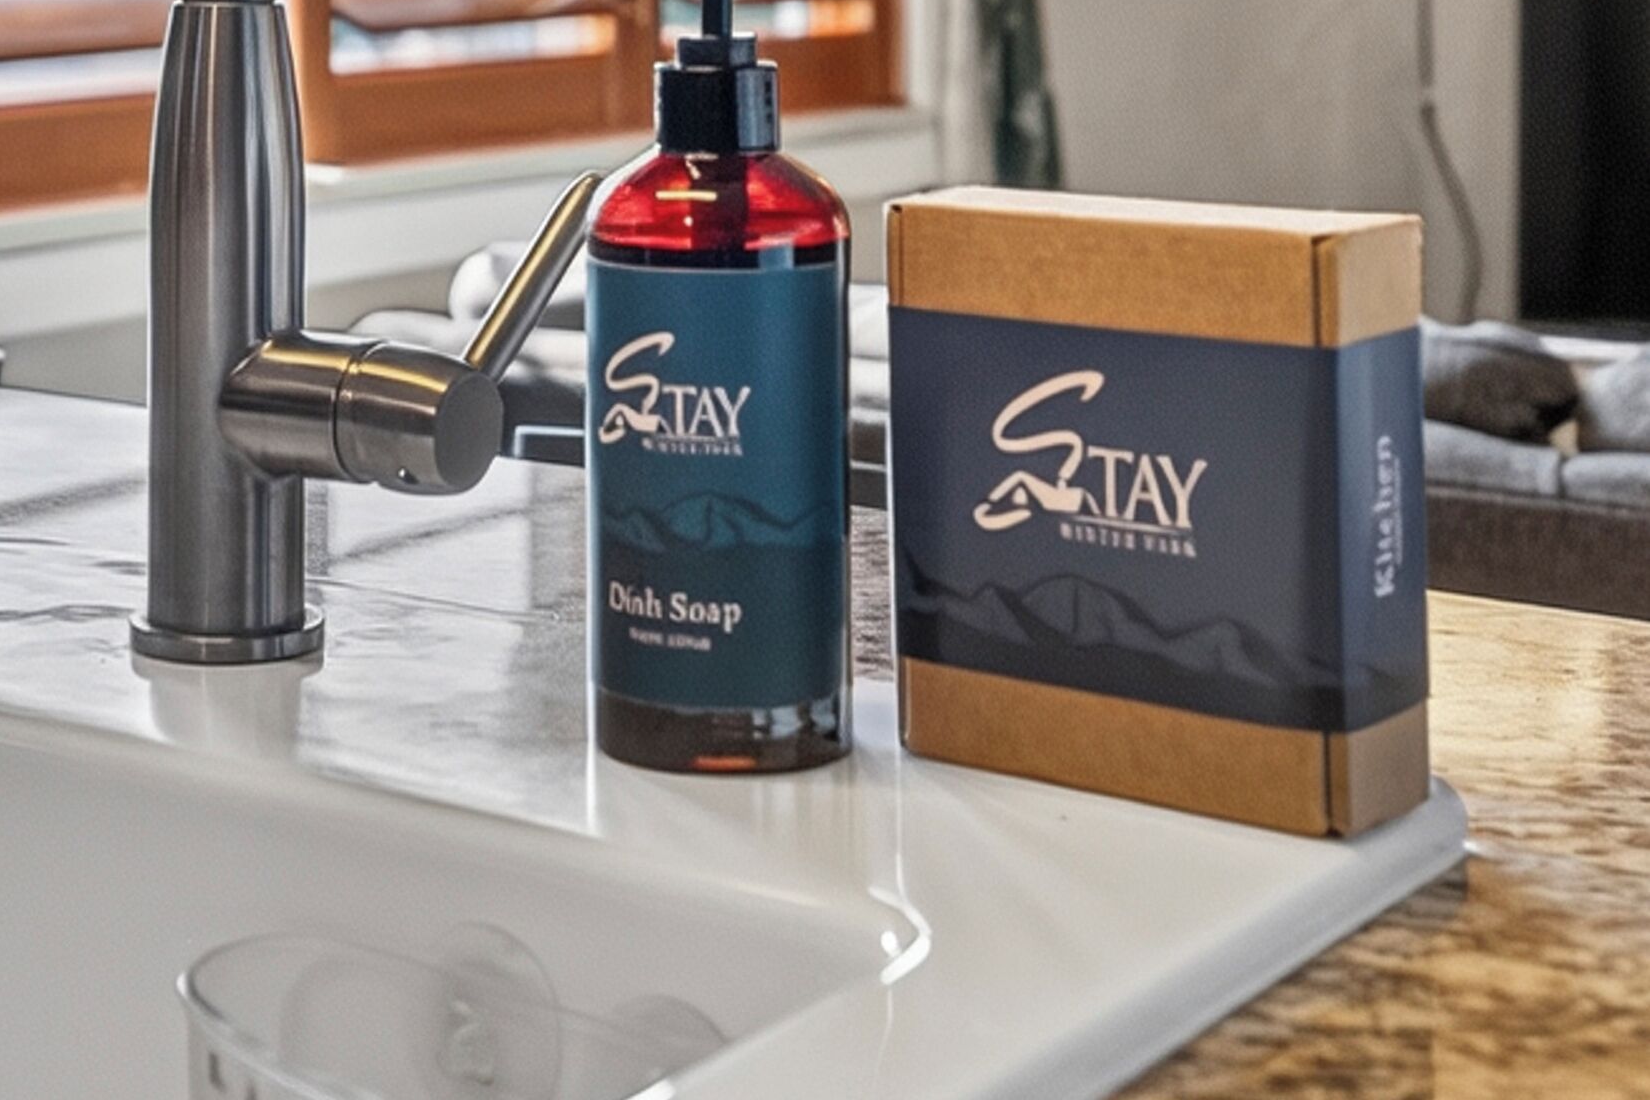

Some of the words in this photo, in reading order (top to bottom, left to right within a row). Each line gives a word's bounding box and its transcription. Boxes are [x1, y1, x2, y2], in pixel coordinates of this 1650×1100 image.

[599, 331, 751, 444] STAY
[974, 370, 1208, 531] STAY
[669, 591, 742, 634] Soap
